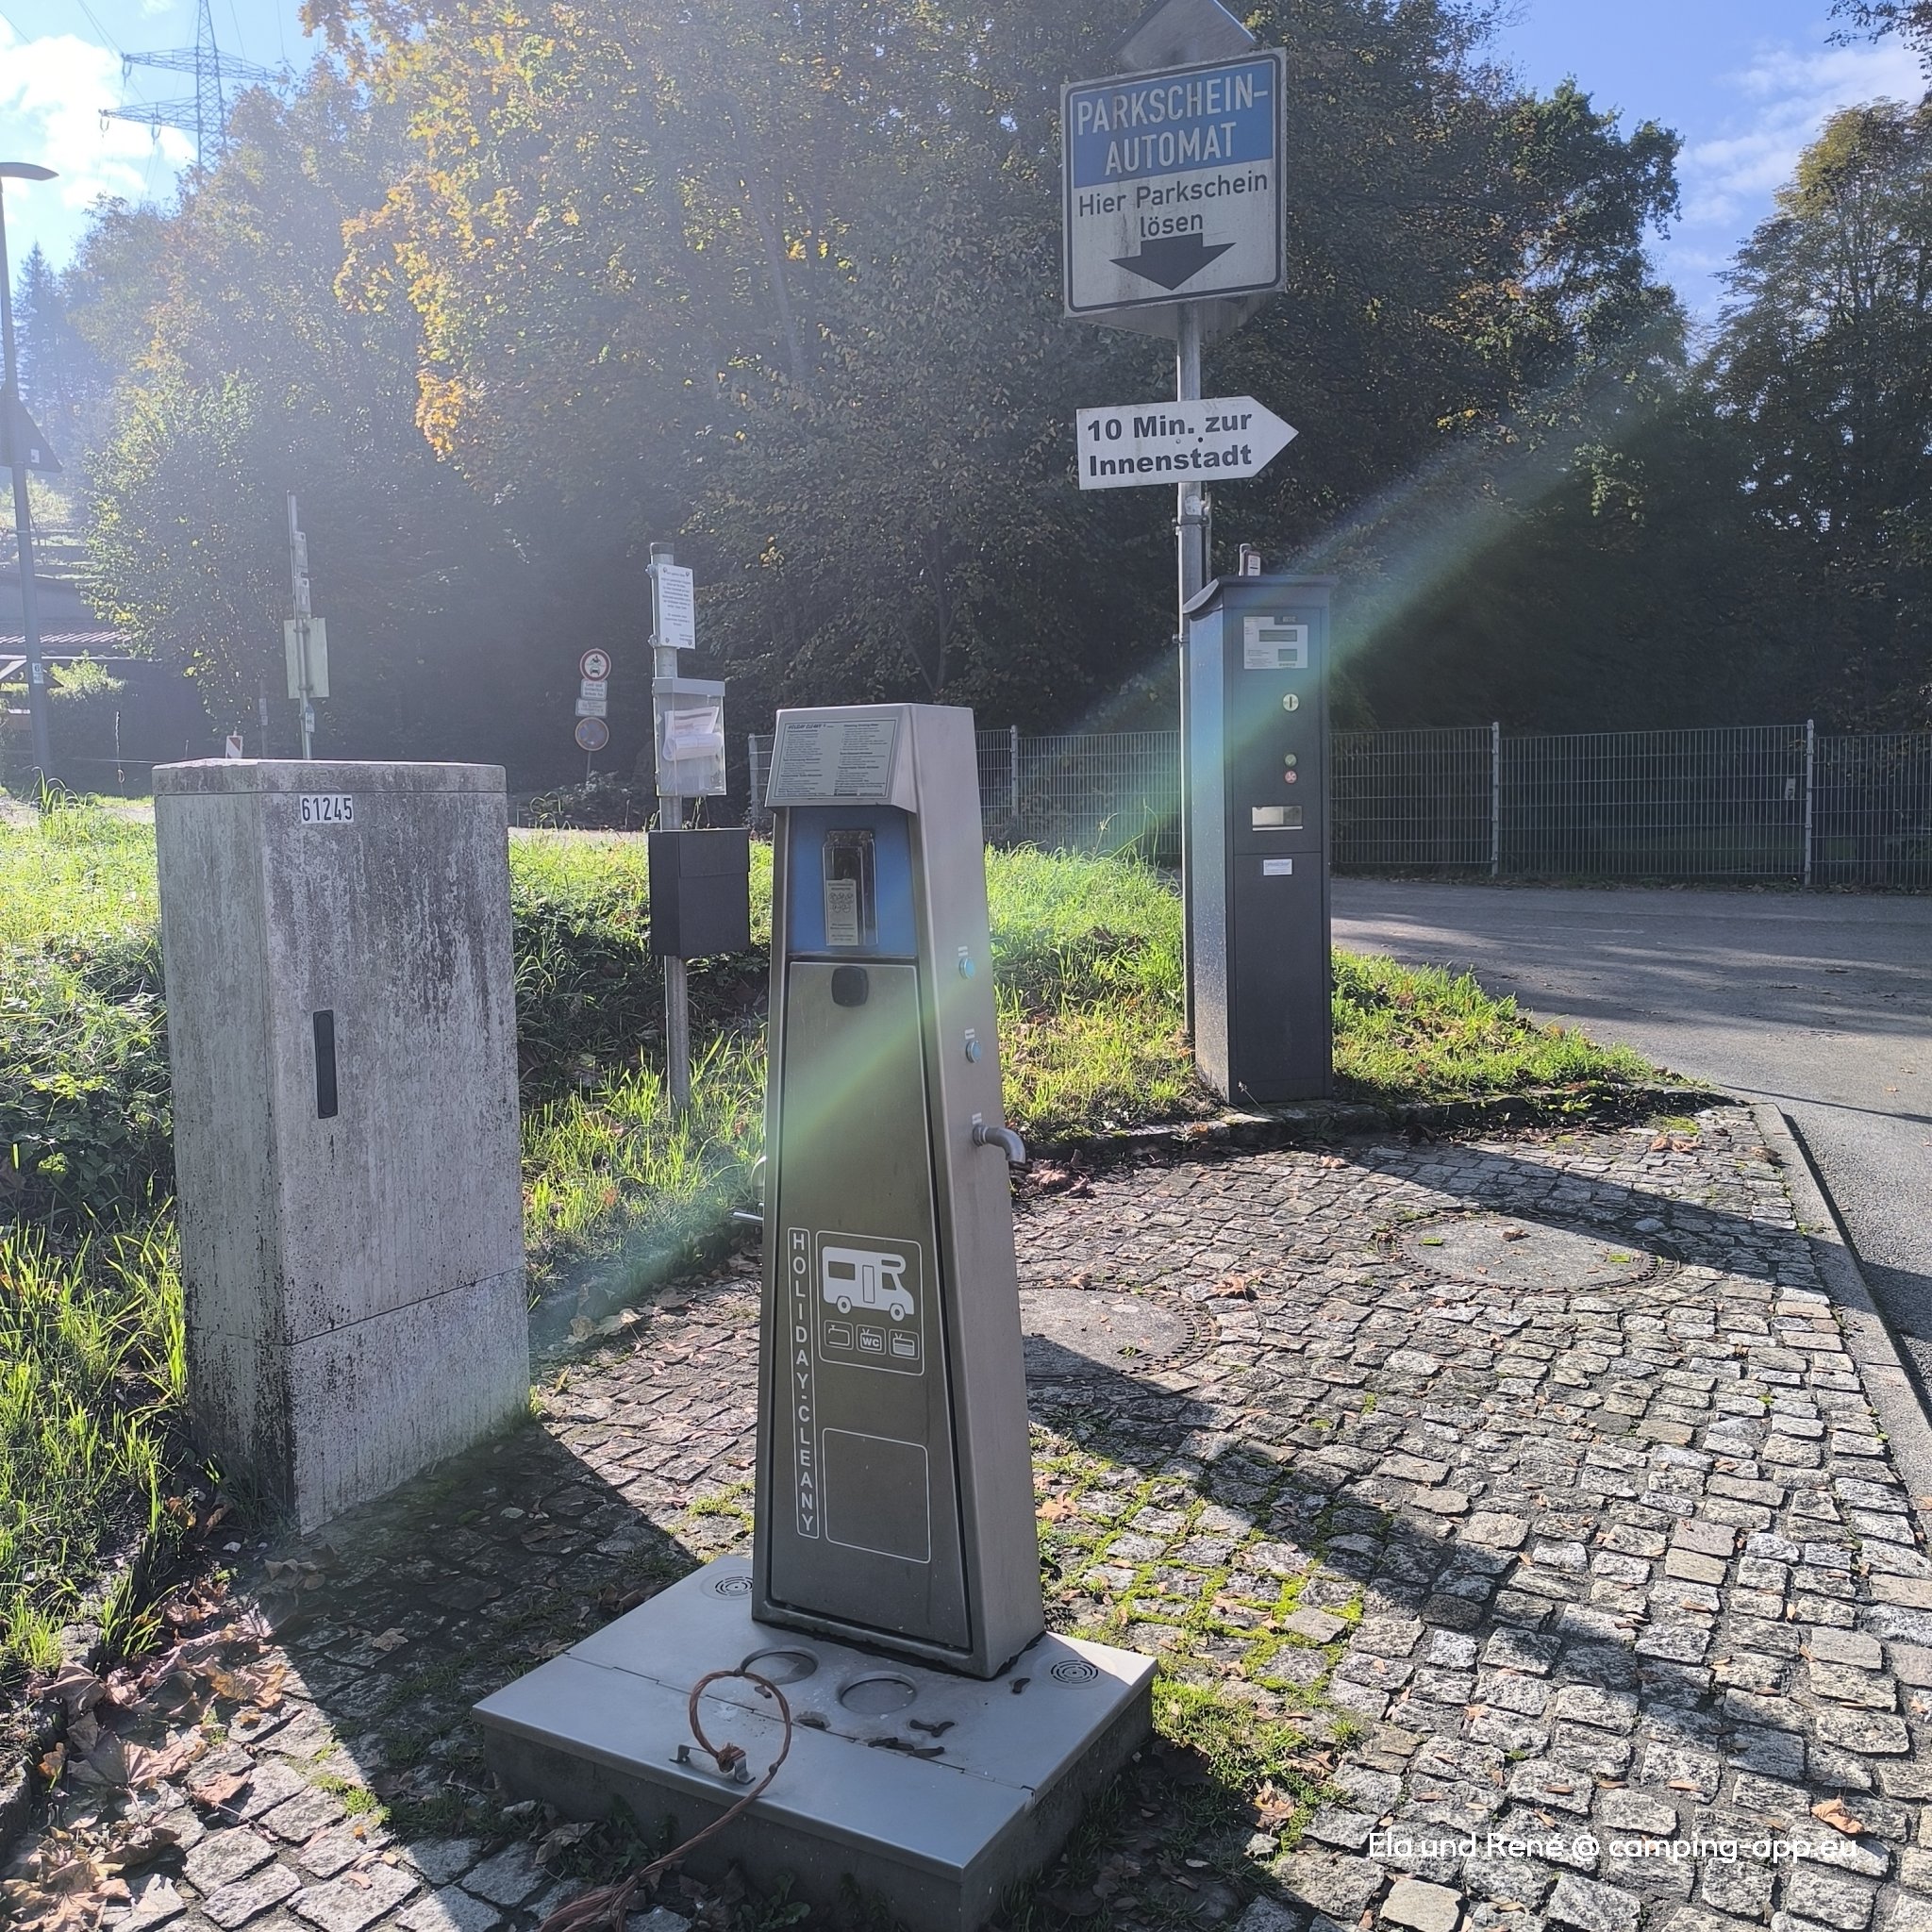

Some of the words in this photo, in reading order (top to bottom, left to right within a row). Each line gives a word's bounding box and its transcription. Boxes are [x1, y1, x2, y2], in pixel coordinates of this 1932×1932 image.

[1077, 74, 1268, 136] PARKSCHEIN-
[1105, 122, 1237, 176] AUTOMAT
[1079, 192, 1126, 217] Hier
[1136, 170, 1267, 208] Parkschein
[1141, 213, 1203, 237] lösen
[1088, 418, 1122, 441] 10
[1134, 415, 1194, 438] Min.
[1206, 413, 1252, 433] zur
[1090, 444, 1252, 476] Innenstadt
[302, 797, 352, 821] 61245
[862, 1337, 880, 1347] WC
